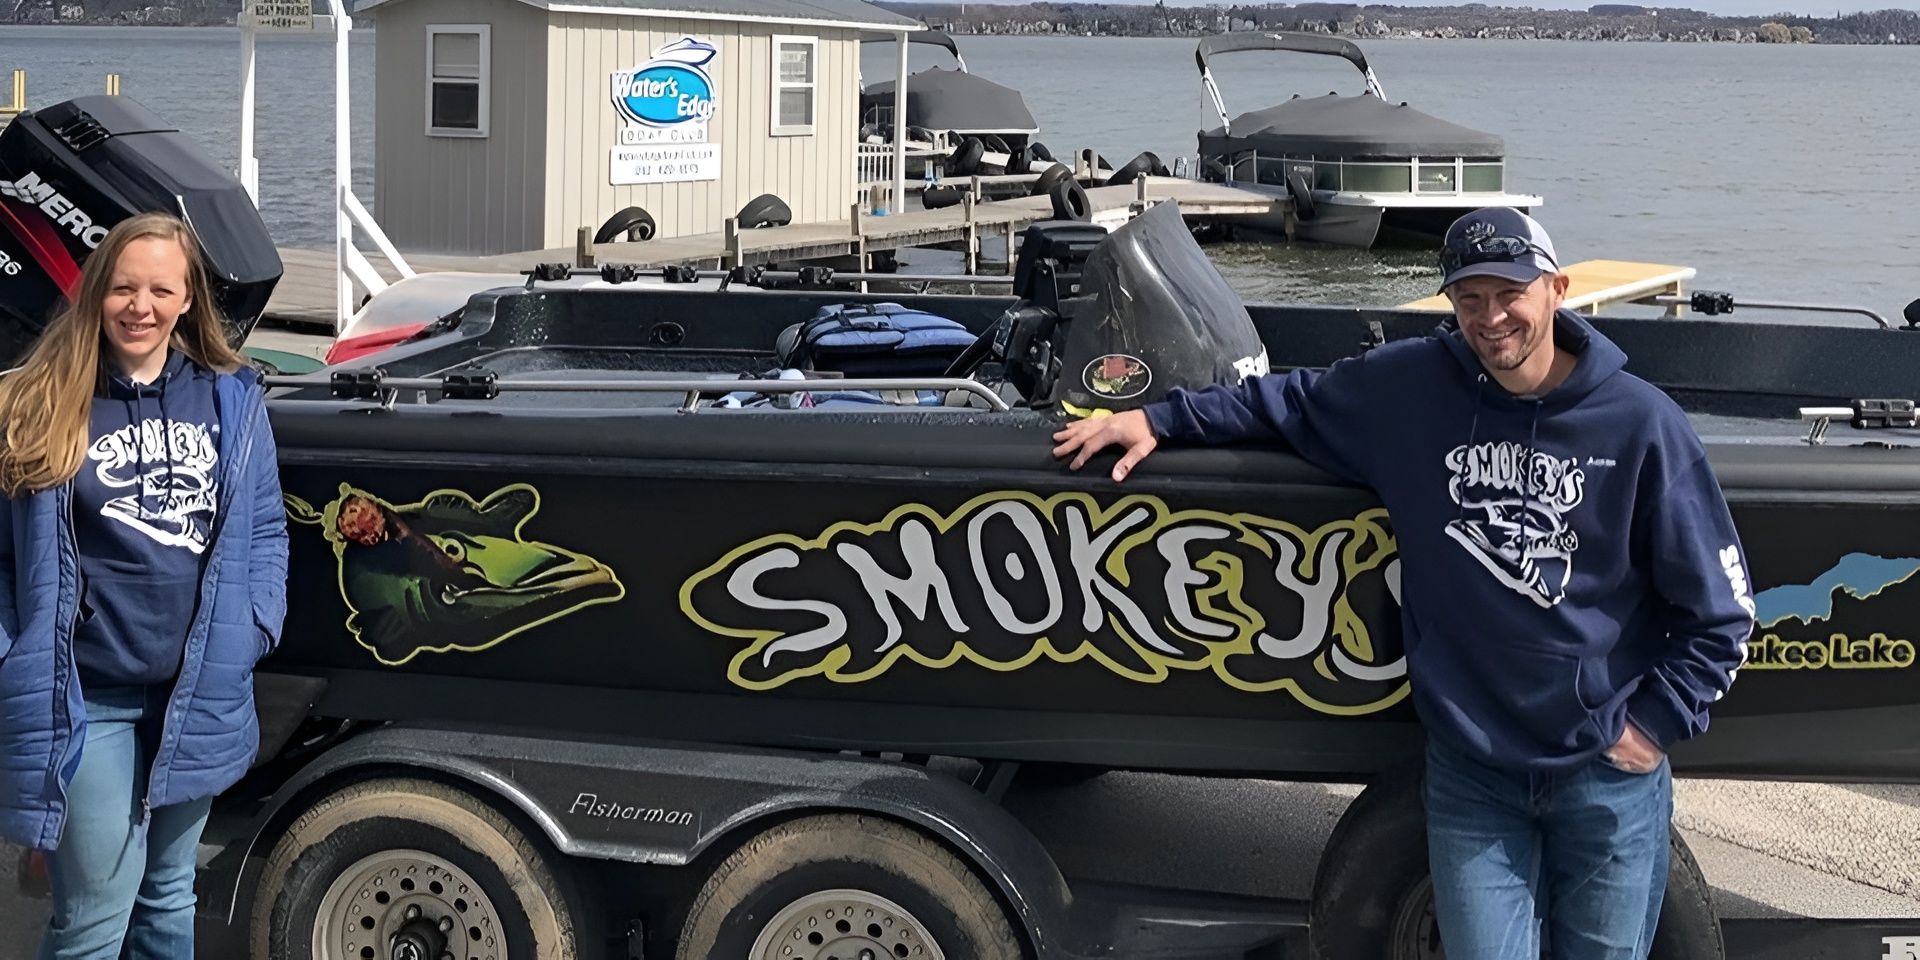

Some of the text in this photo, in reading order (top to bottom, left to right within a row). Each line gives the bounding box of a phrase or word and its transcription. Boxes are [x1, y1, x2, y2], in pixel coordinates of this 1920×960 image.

[14, 171, 109, 249] MERC
[1747, 634, 1912, 667] ukee Lake
[568, 793, 693, 826] Fisherman
